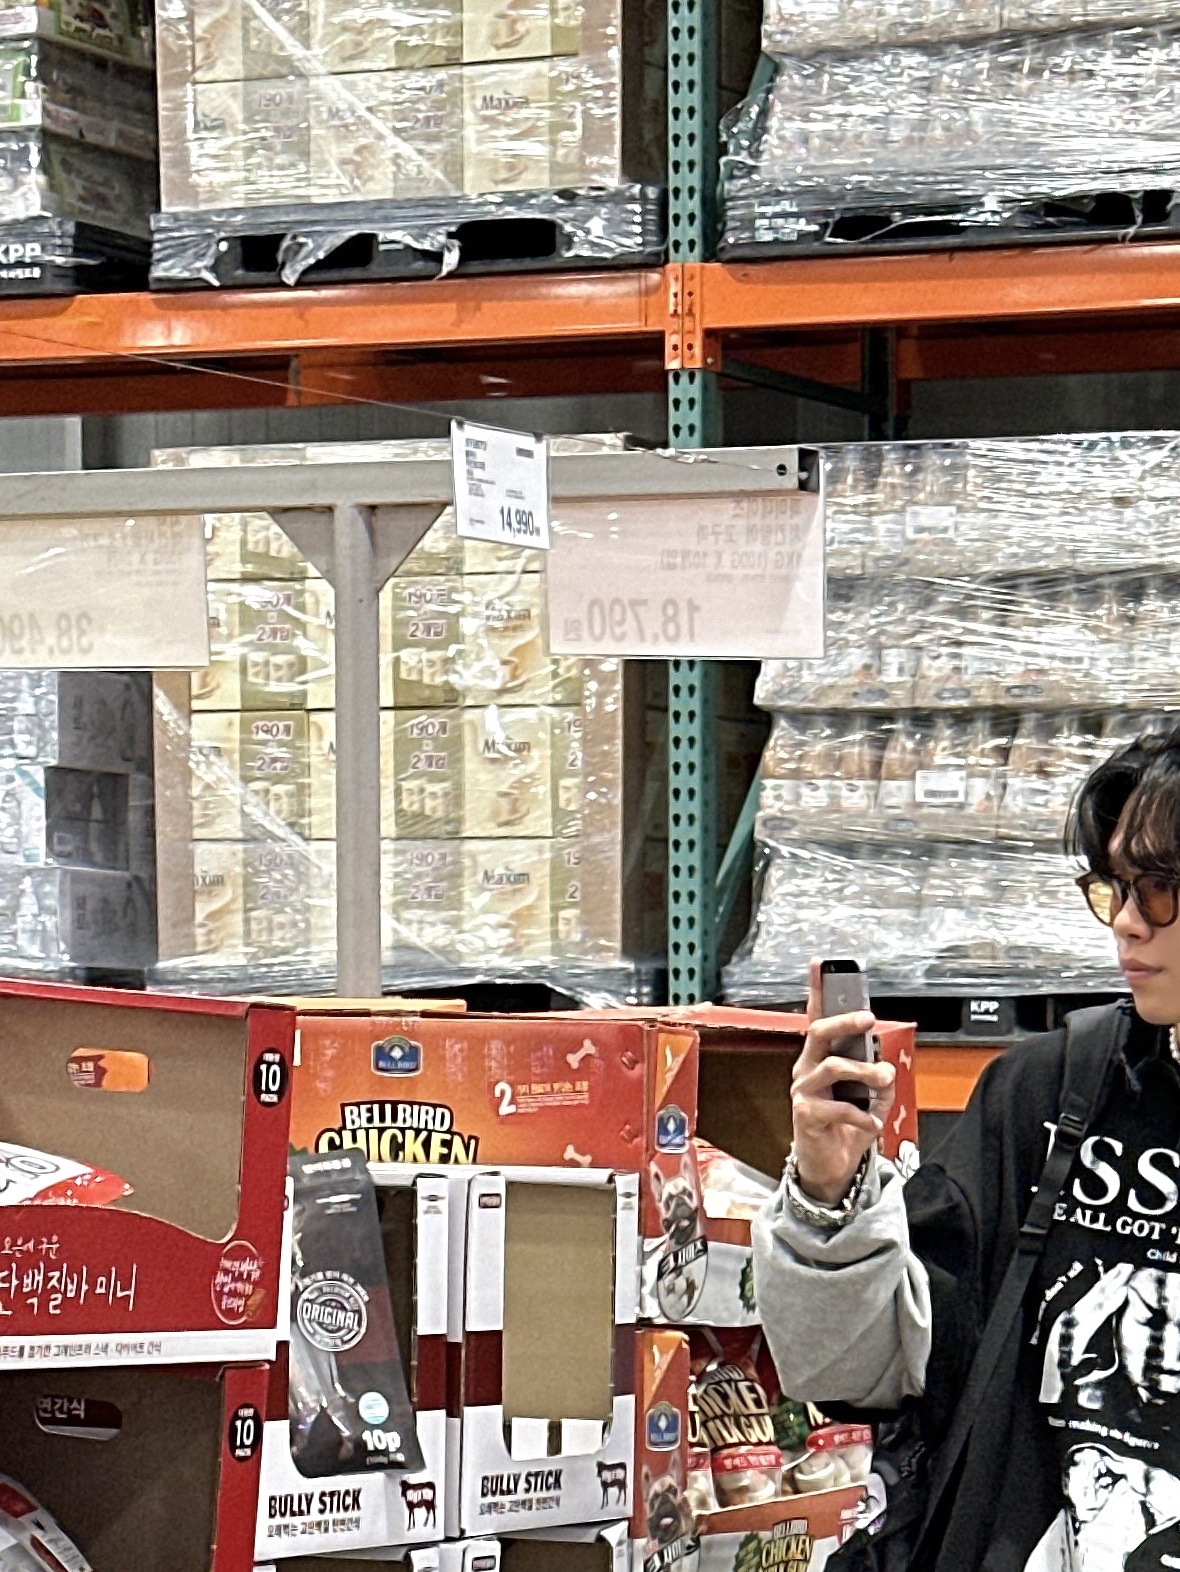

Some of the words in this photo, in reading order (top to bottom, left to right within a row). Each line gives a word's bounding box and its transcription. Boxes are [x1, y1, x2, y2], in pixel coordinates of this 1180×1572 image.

[260, 1063, 280, 1092] 10
[494, 1081, 517, 1116] 2
[344, 1104, 452, 1130] BELLBIRD
[318, 1129, 479, 1165] CHICKEN
[1069, 1206, 1111, 1231] ALL
[1116, 1216, 1166, 1241] GOT
[95, 1263, 138, 1312] 미니
[303, 1302, 360, 1331] ORIGINAL
[234, 1419, 255, 1447] 10
[361, 1427, 401, 1452] 10p
[481, 1472, 522, 1499] BULLY
[524, 1469, 563, 1495] STICK
[269, 1491, 314, 1520] BULLY
[318, 1487, 362, 1515] STICK
[763, 1535, 816, 1567] CHICKEN
